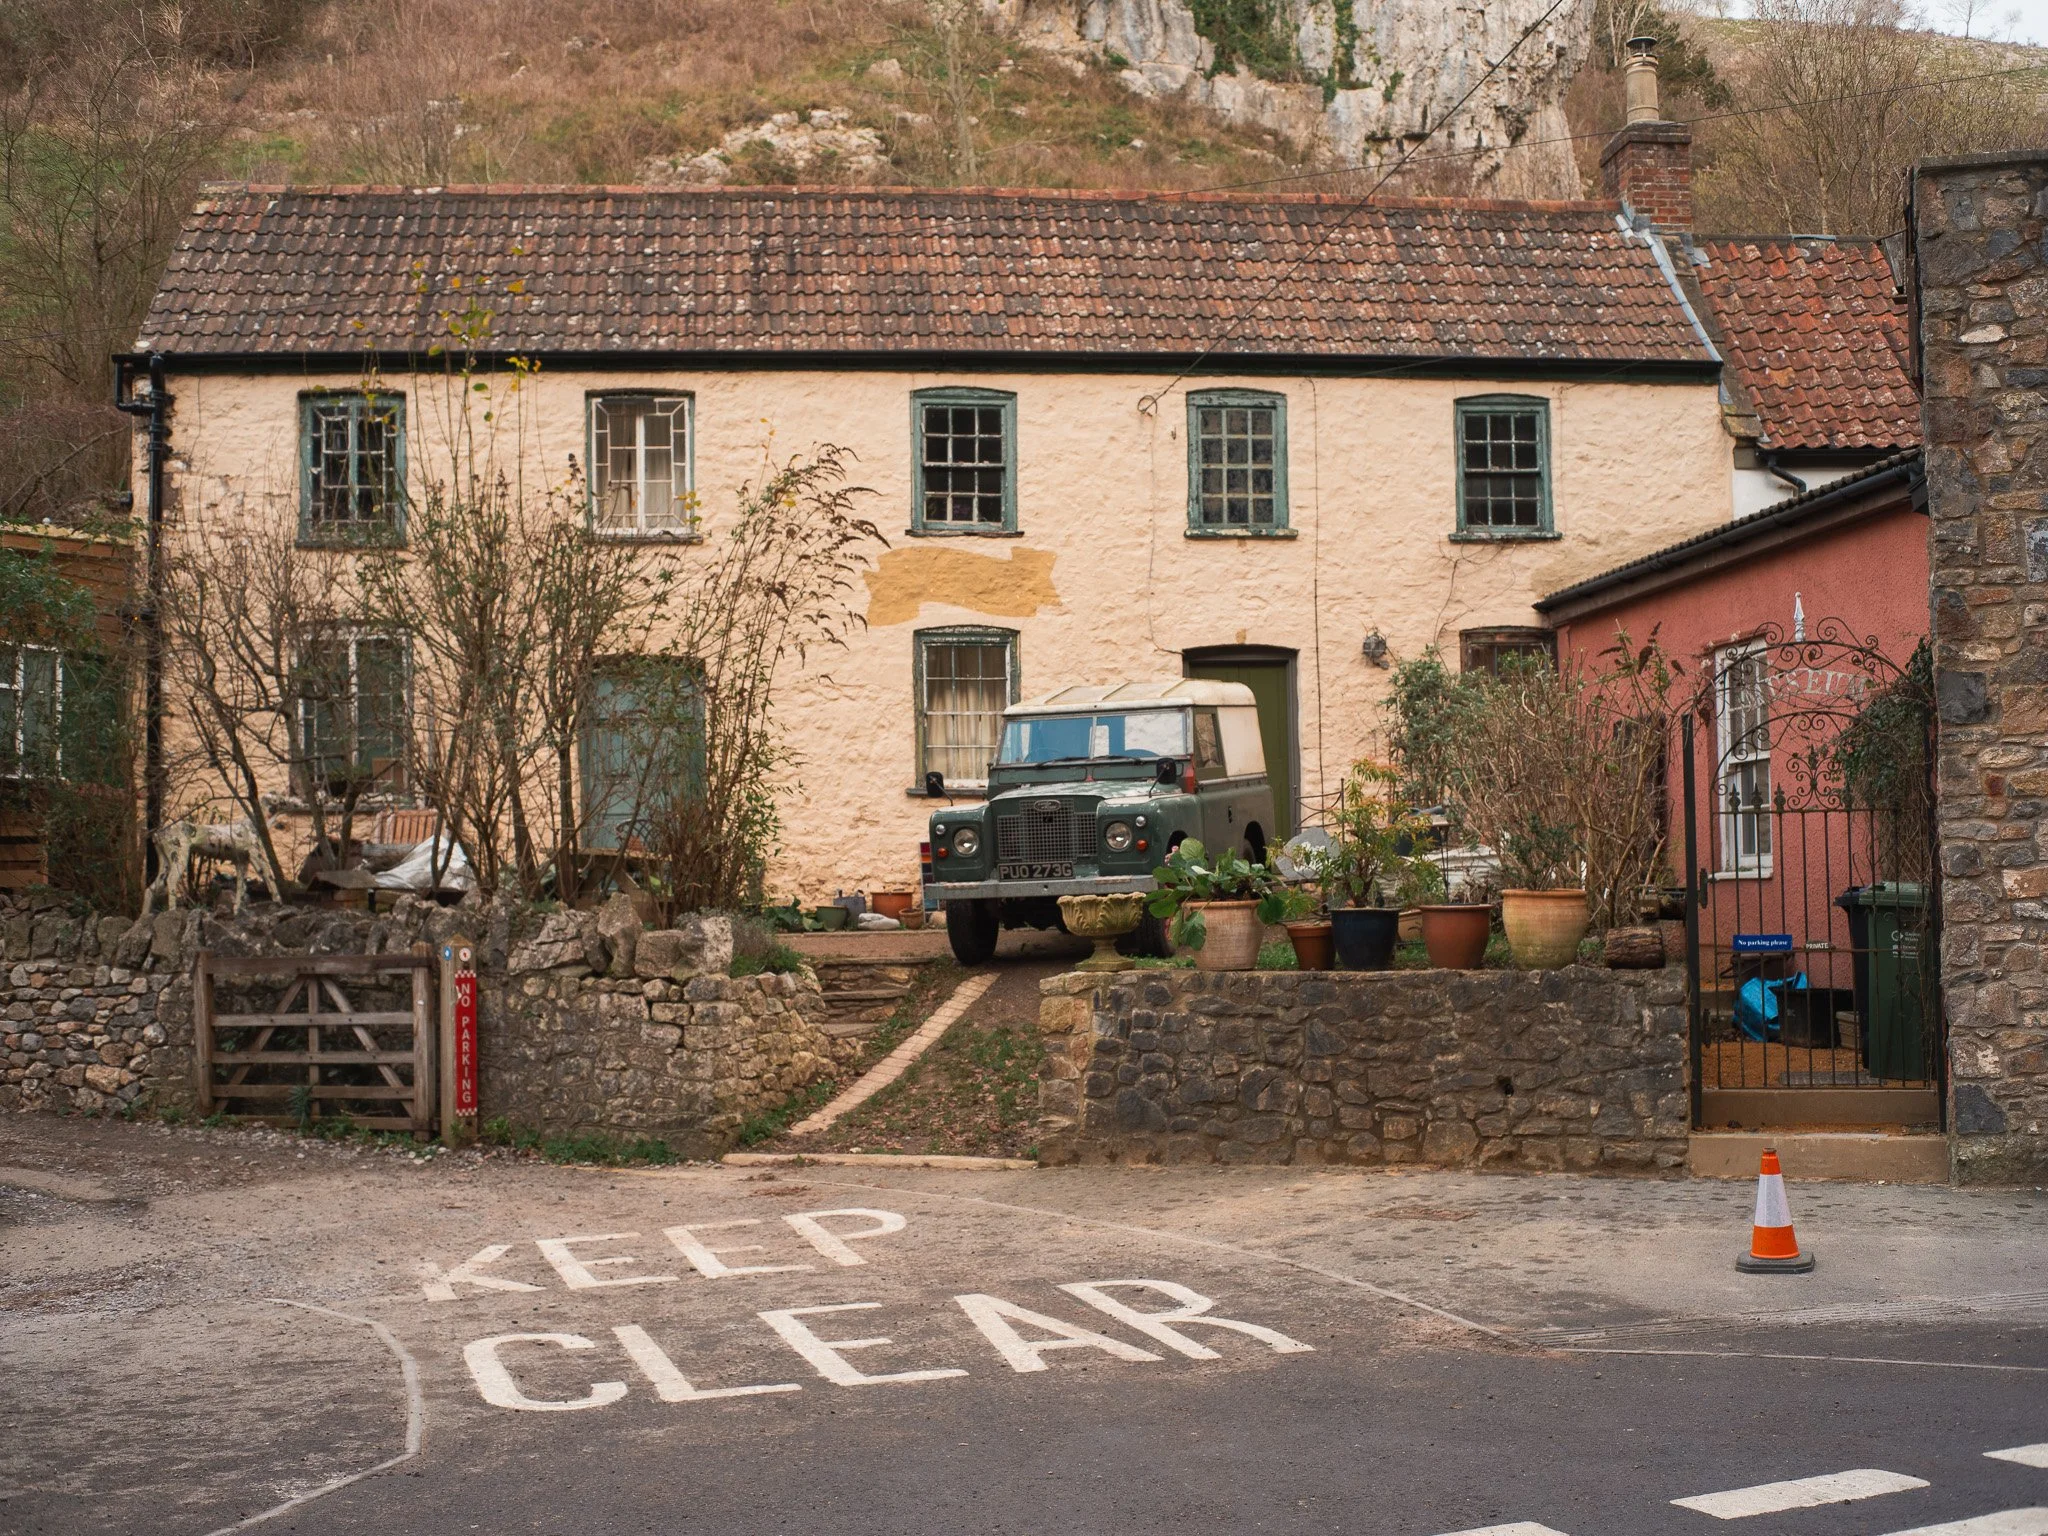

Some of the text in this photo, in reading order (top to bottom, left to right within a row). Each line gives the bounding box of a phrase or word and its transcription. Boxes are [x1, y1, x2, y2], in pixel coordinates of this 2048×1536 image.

[999, 863, 1072, 879] PUO 273G
[1747, 939, 1770, 947] parking
[1770, 939, 1788, 947] please
[461, 983, 472, 1103] NO PARKING
[419, 1208, 908, 1302] KEEP
[462, 1278, 1316, 1412] CLEAR
